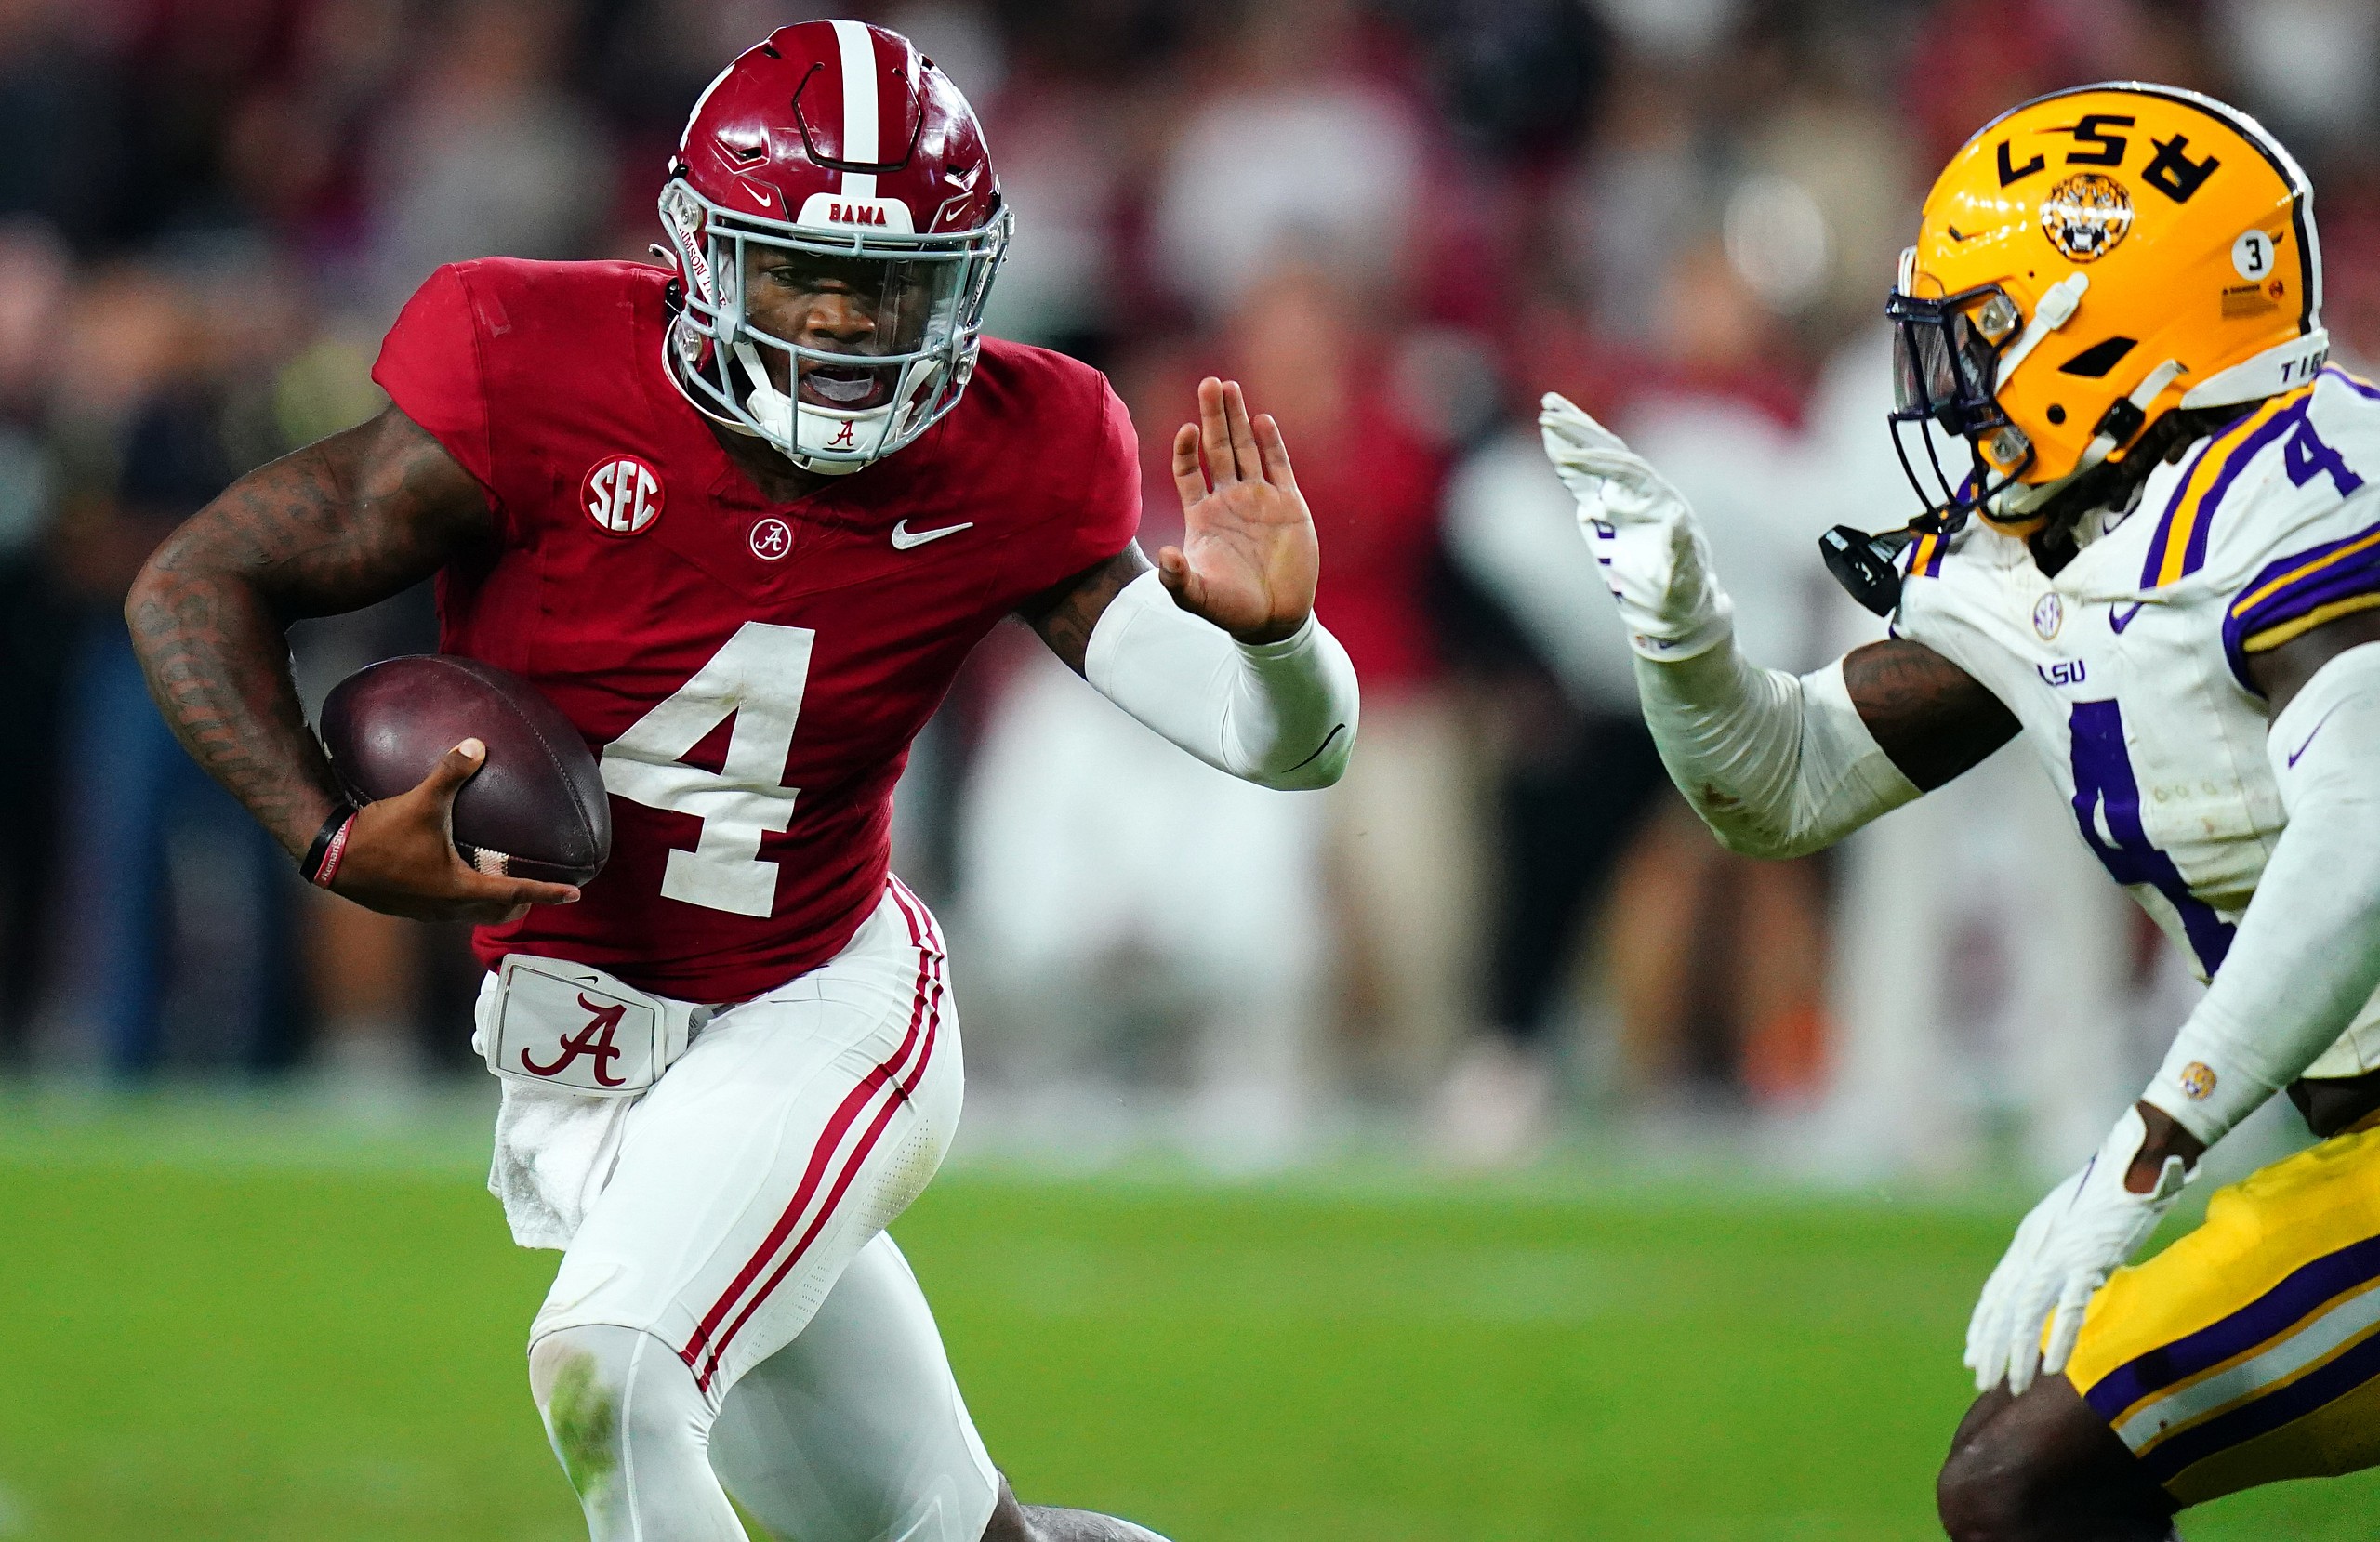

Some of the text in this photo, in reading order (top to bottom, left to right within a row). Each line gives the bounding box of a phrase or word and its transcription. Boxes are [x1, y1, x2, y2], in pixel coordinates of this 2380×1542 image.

[829, 203, 887, 225] BAMA
[679, 228, 708, 276] IMSON
[2245, 237, 2263, 272] 3
[826, 419, 855, 447] A
[2283, 415, 2364, 497] 4
[588, 461, 658, 532] SEC
[755, 523, 784, 552] A
[2036, 659, 2086, 687] LSU
[599, 621, 816, 918] 4
[2069, 698, 2238, 979] 4
[521, 991, 628, 1087] A
